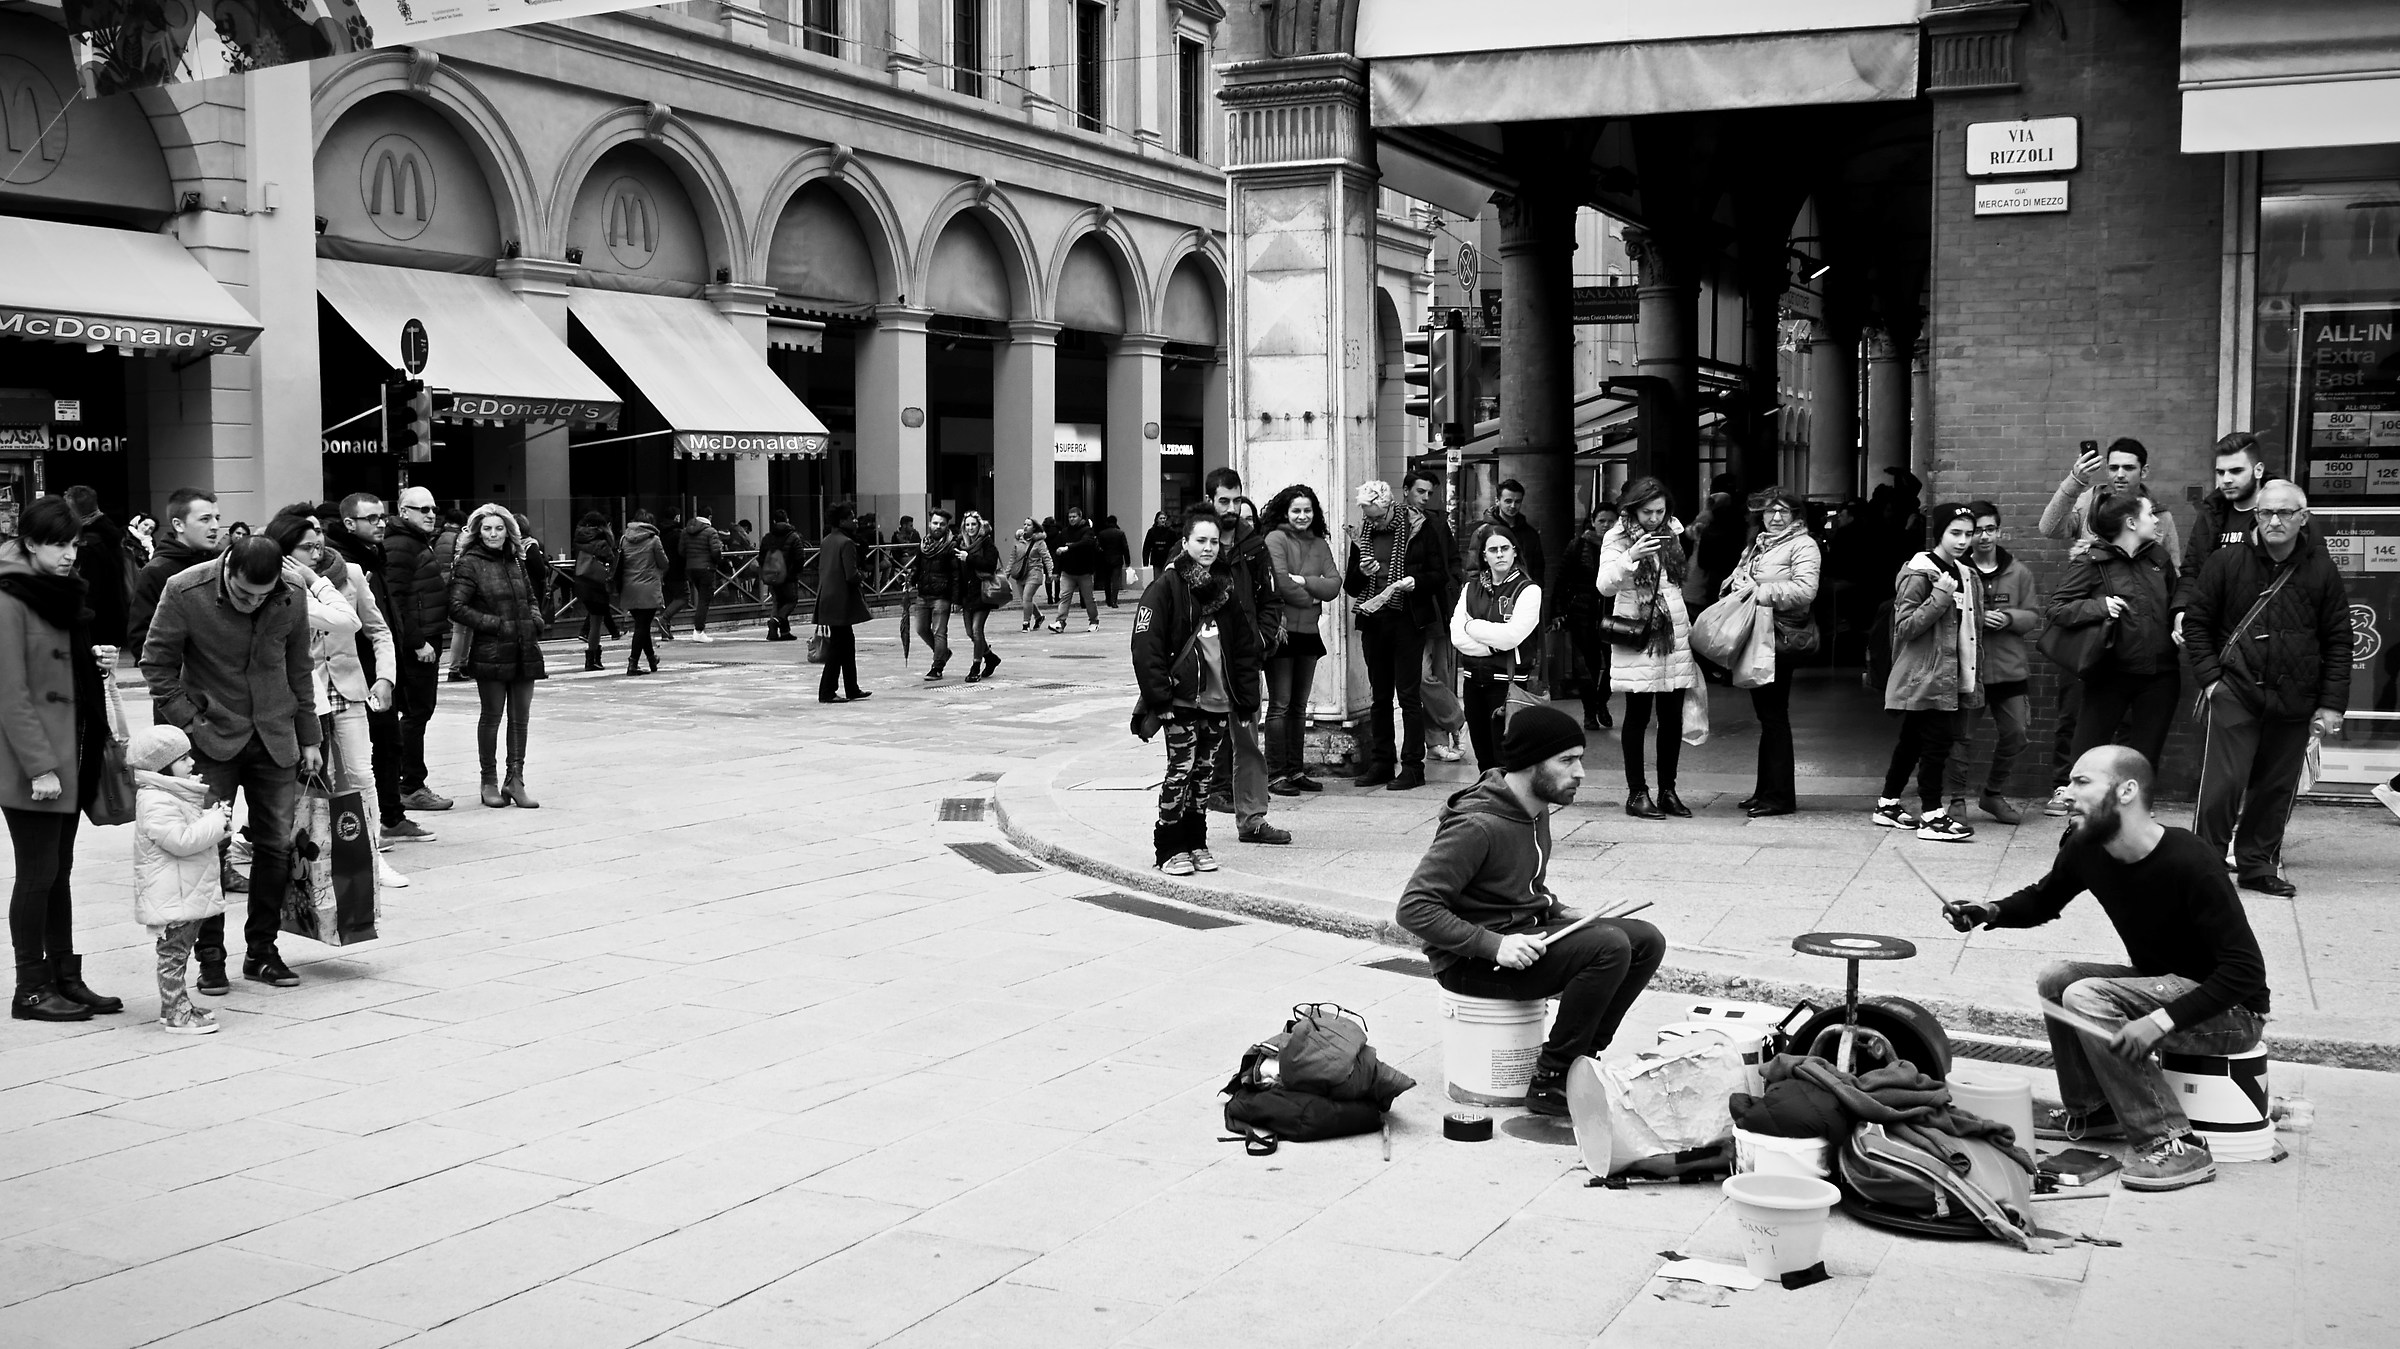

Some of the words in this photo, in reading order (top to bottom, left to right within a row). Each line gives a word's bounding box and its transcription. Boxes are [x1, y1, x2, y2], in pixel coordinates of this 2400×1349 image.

[2009, 129, 2034, 143] VIA
[1990, 147, 2053, 165] RIZZOLI
[371, 149, 426, 221] M
[1978, 199, 2020, 209] MERCATO
[2023, 198, 2031, 207] DI
[2034, 197, 2064, 206] MEZZO
[610, 190, 651, 252] M
[0, 313, 229, 348] McDonald's
[2317, 323, 2393, 342] ALL-IN
[2317, 347, 2376, 364] Extra
[2329, 413, 2353, 423] 800
[690, 435, 818, 450] McDonald's
[2325, 432, 2333, 441] 4
[1059, 443, 1087, 453] SUPERGA
[2325, 462, 2353, 472] 1600
[2376, 468, 2399, 478] 12€
[2322, 479, 2330, 489] 4
[2332, 479, 2352, 489] GB
[2374, 545, 2396, 555] 14€
[2332, 556, 2350, 566] GB
